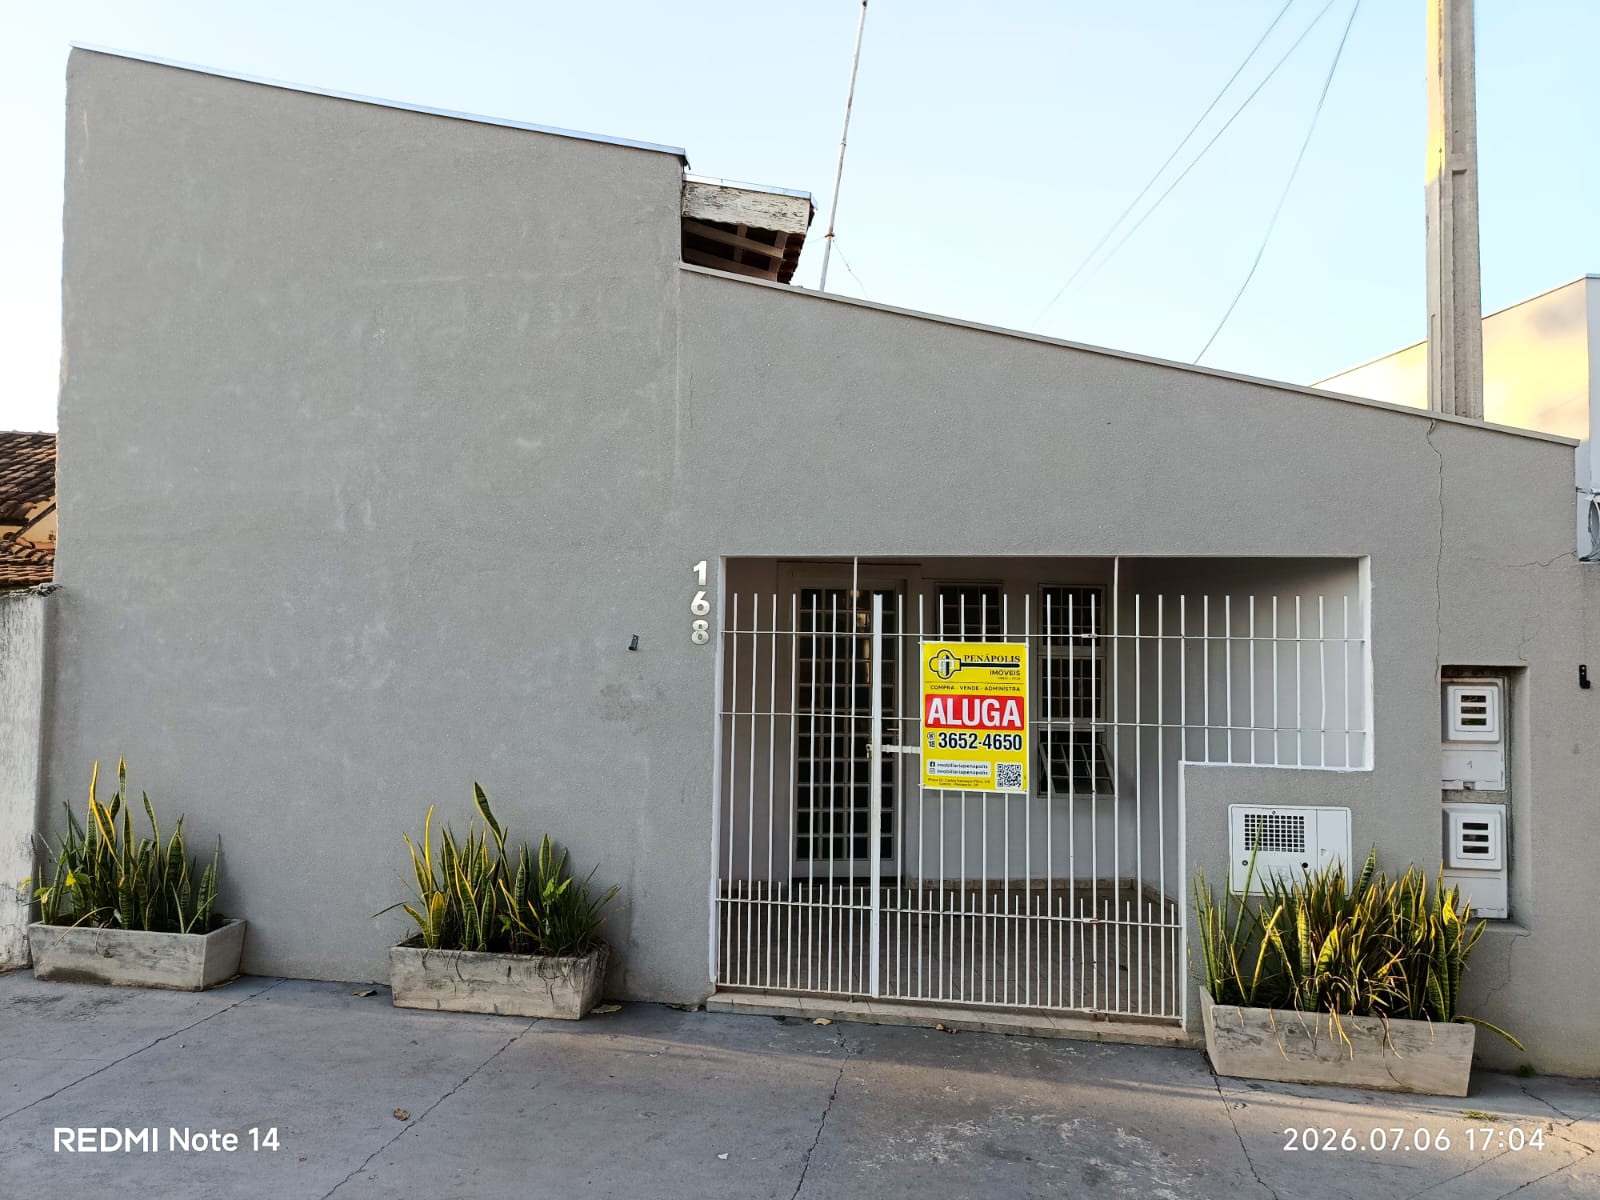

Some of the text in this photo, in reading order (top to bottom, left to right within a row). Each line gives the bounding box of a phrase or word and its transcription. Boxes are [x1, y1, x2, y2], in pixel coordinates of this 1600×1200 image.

[690, 560, 710, 645] 168
[963, 653, 1021, 663] PENÁPOLIS
[927, 697, 1022, 727] ALUGA
